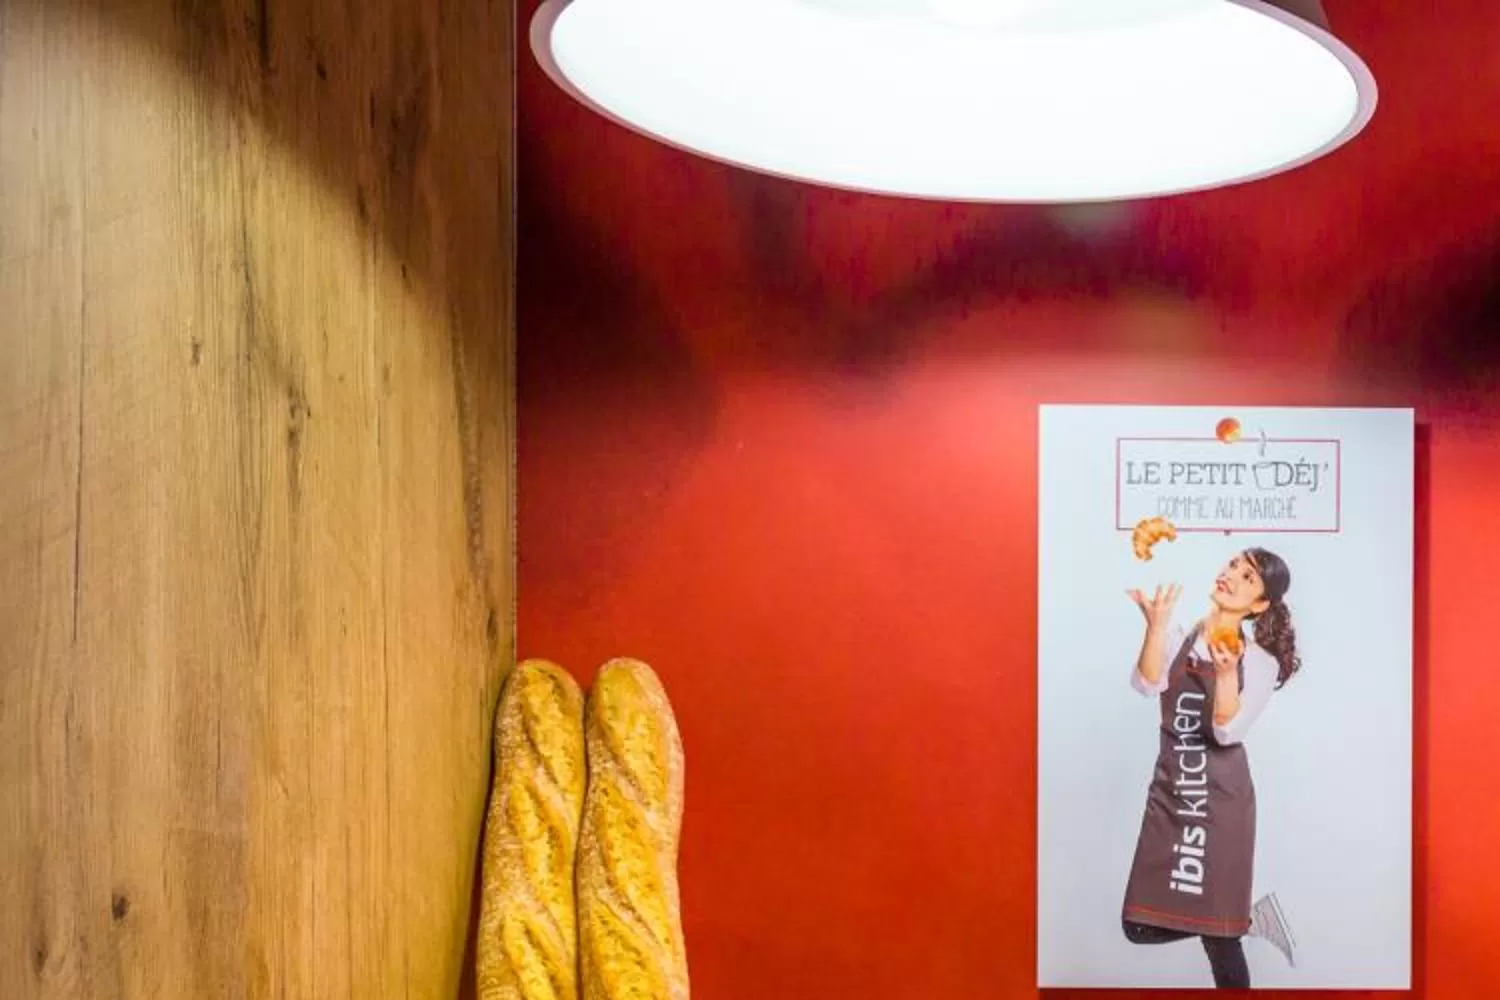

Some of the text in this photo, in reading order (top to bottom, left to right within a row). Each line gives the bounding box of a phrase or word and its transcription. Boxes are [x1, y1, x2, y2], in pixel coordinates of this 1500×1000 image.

[1126, 461, 1161, 485] LE
[1169, 461, 1247, 485] PETIT
[1157, 495, 1209, 519] COMME
[1215, 495, 1234, 519] AU
[1169, 691, 1209, 896] ibis kitchen
